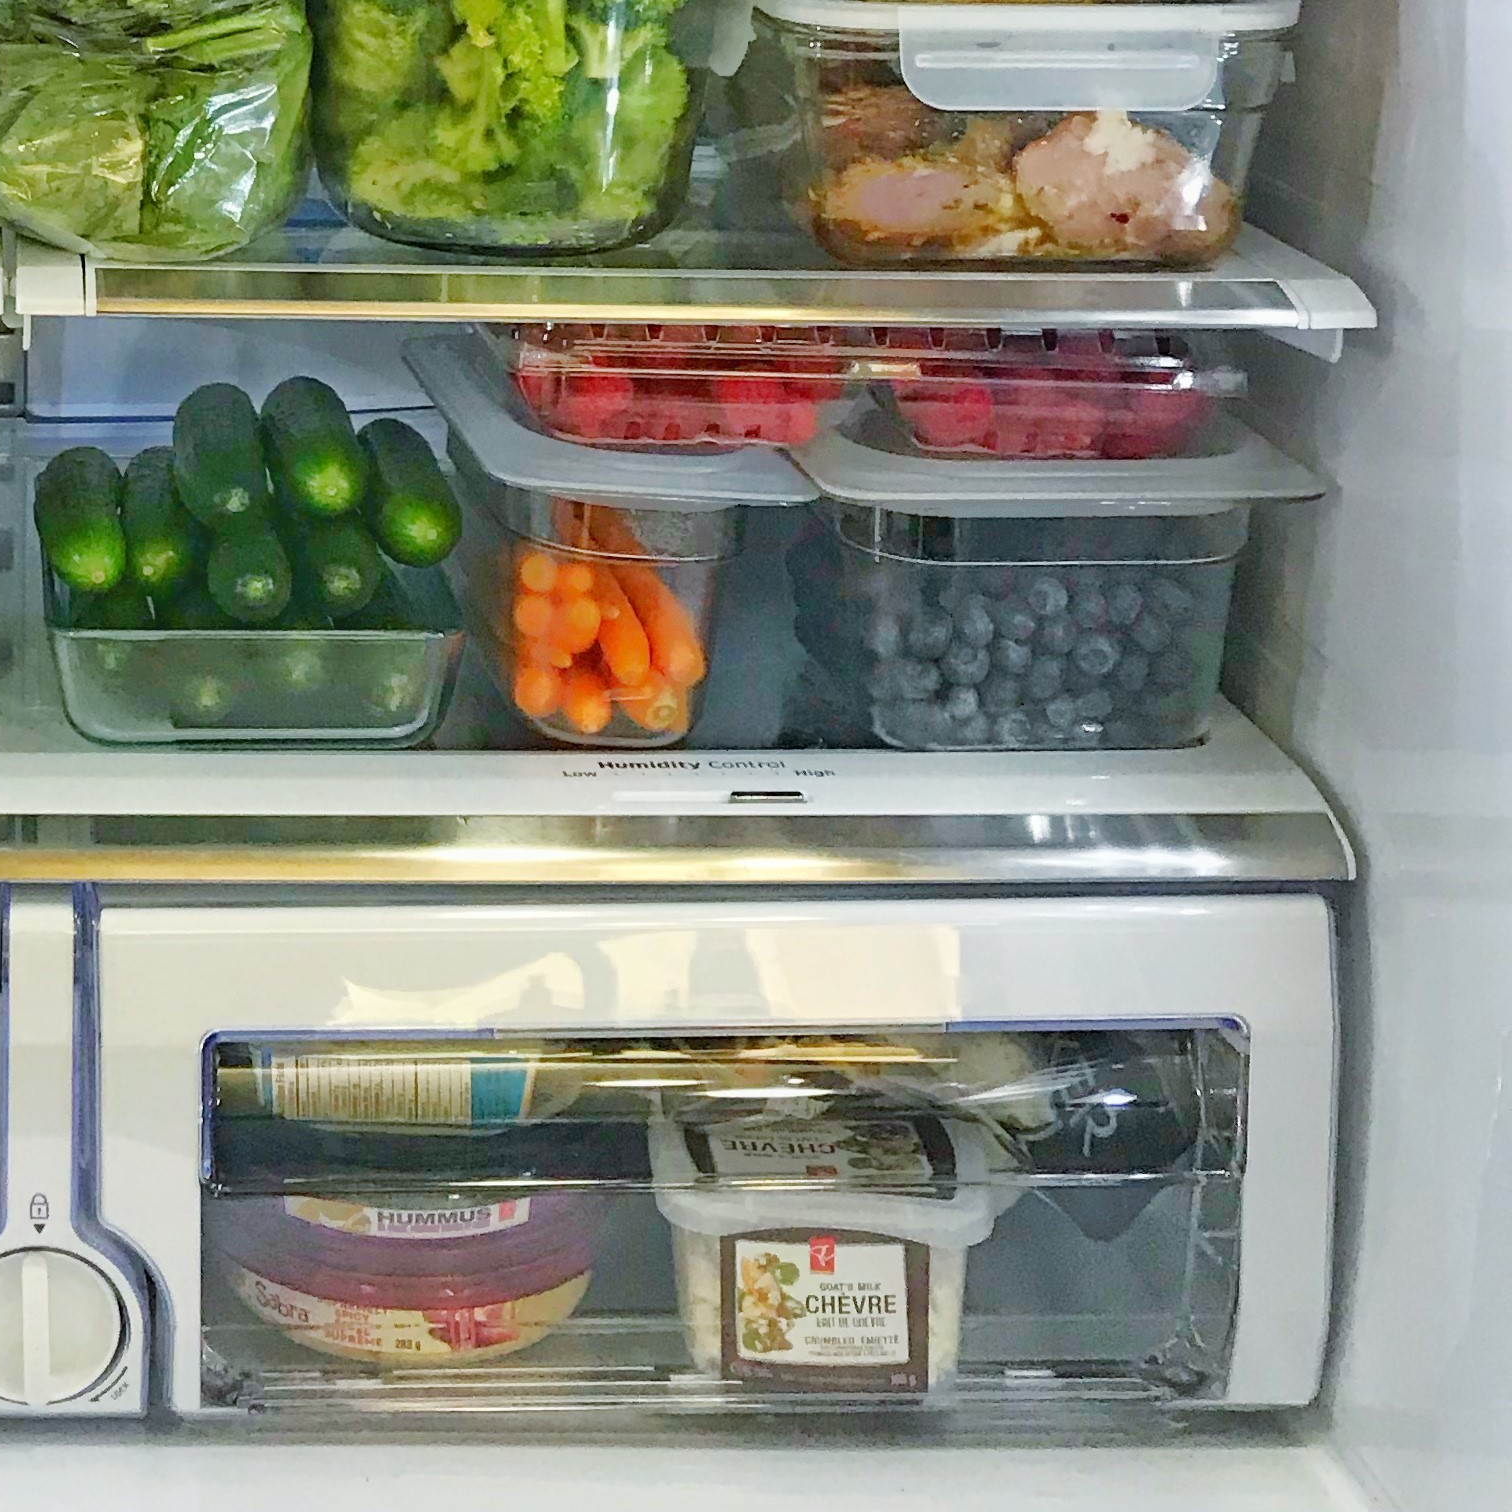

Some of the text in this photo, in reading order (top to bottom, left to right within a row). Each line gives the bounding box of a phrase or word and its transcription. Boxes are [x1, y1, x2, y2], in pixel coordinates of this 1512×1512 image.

[597, 759, 786, 771] Humidity Control
[562, 770, 598, 778] Low
[794, 768, 836, 778] High
[377, 1207, 492, 1225] HUMMUS
[255, 1281, 310, 1322] Sabra
[805, 1292, 898, 1315] CHÈVRE
